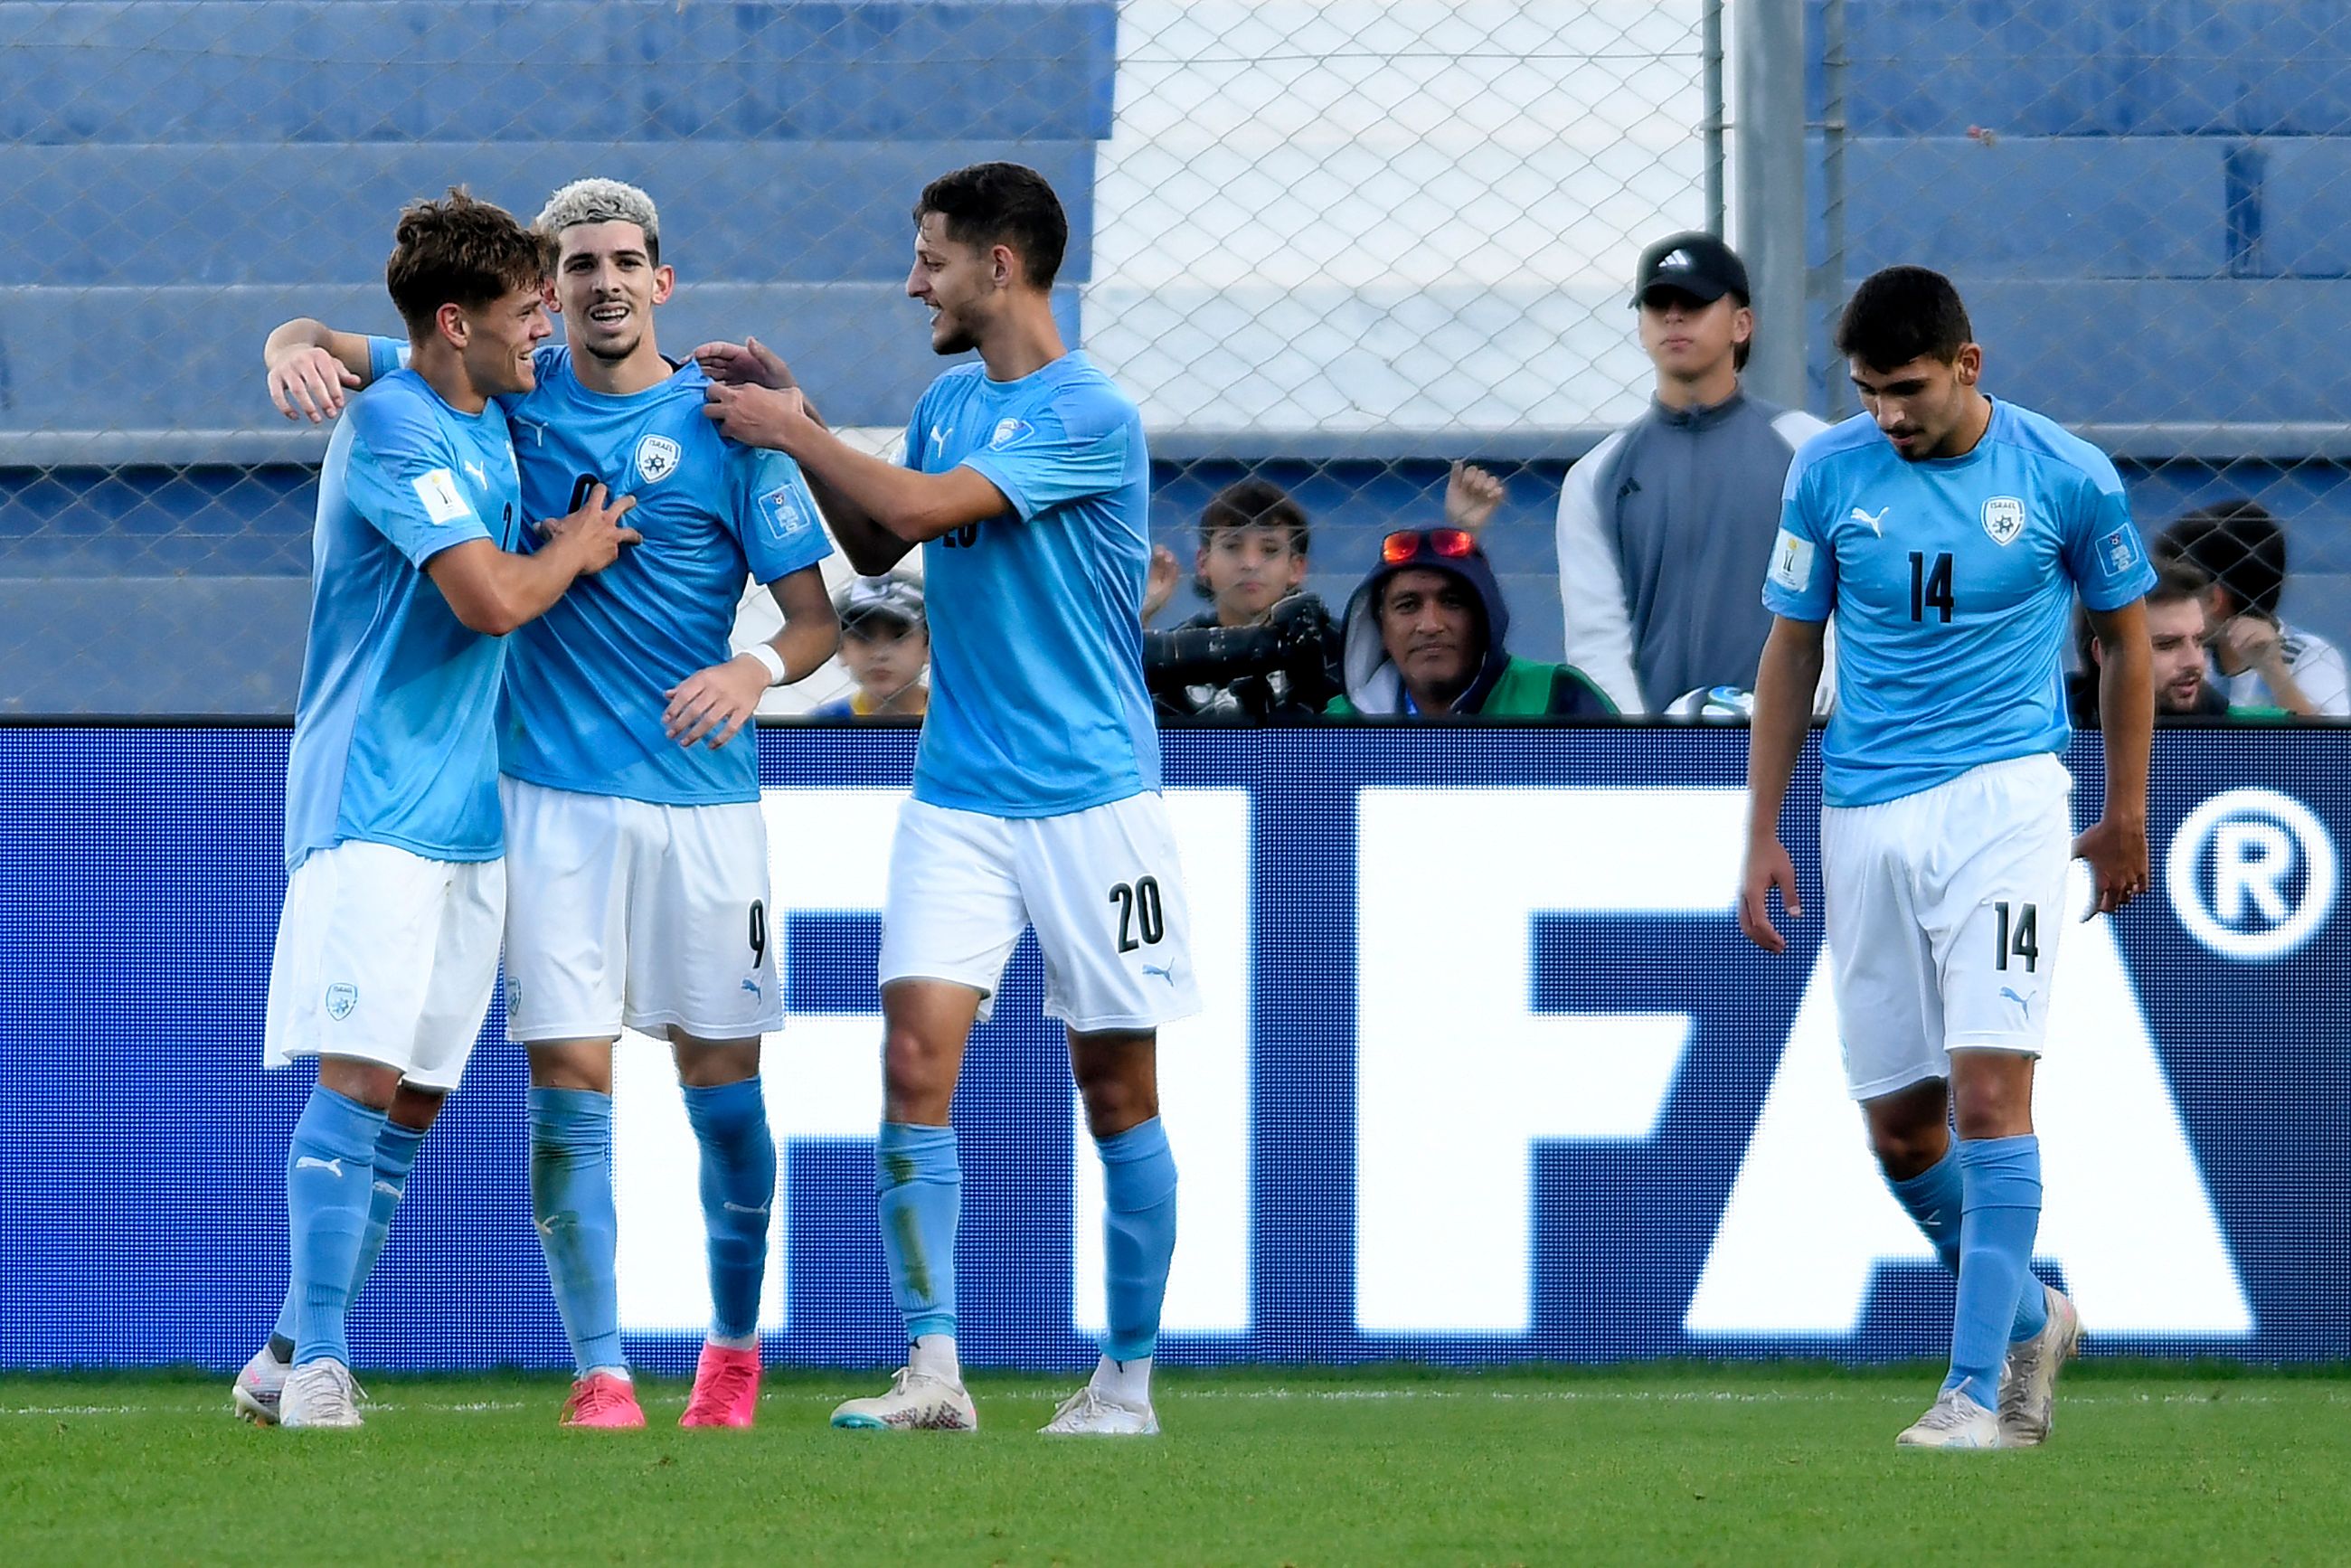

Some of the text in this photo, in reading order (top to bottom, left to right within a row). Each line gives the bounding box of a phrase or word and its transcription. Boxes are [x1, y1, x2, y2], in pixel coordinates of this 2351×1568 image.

[648, 439, 674, 452] ISRAEL
[1908, 551, 1955, 624] 14
[749, 898, 766, 969] 9
[1109, 874, 1165, 954] 20
[1994, 901, 2039, 974] 14
